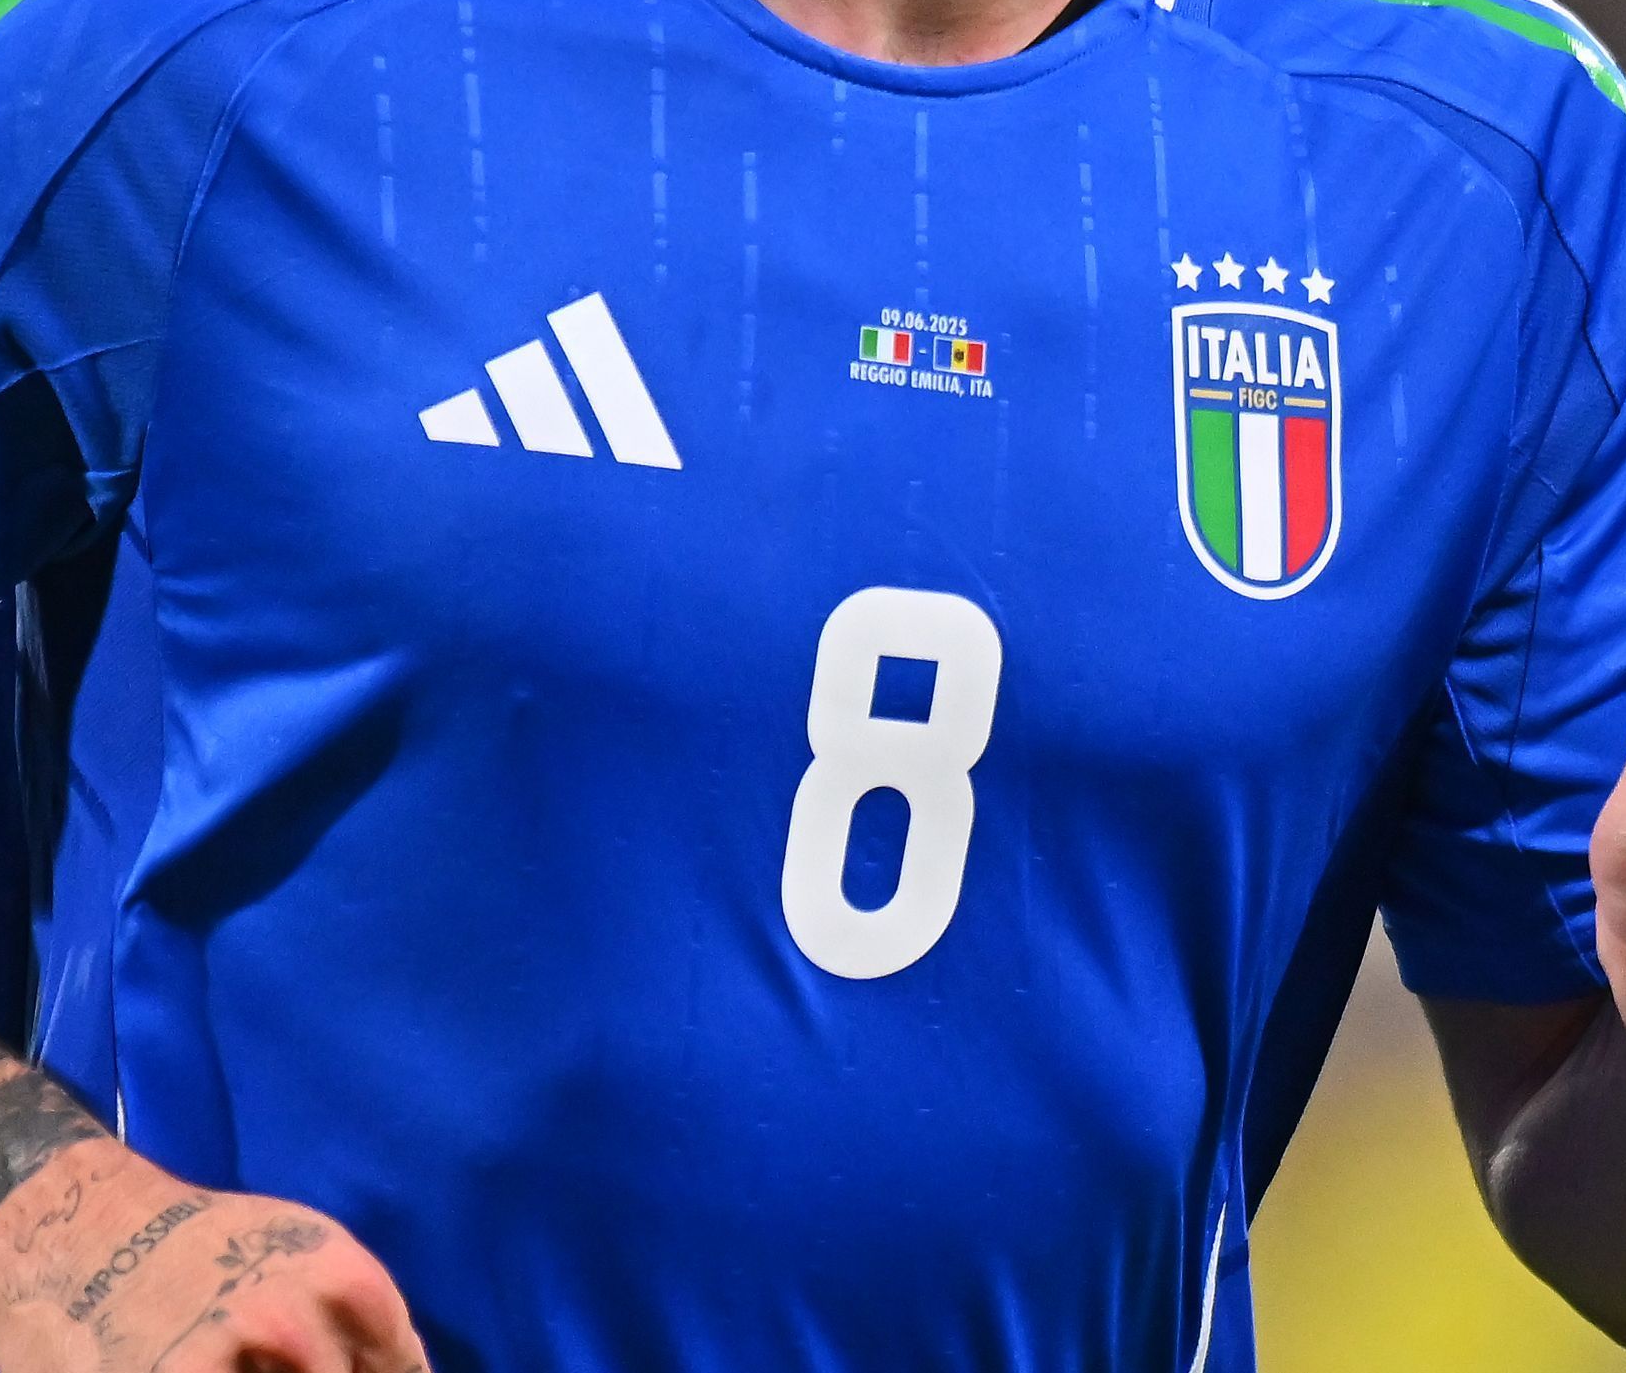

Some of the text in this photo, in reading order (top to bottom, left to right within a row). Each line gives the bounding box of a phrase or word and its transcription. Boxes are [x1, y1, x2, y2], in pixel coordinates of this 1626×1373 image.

[881, 308, 968, 336] 09.06.2025
[1188, 325, 1326, 389] ITALIA
[850, 362, 993, 398] REGGIO EMILIA, ITA
[1238, 387, 1278, 410] FIGC
[781, 586, 1002, 979] 8
